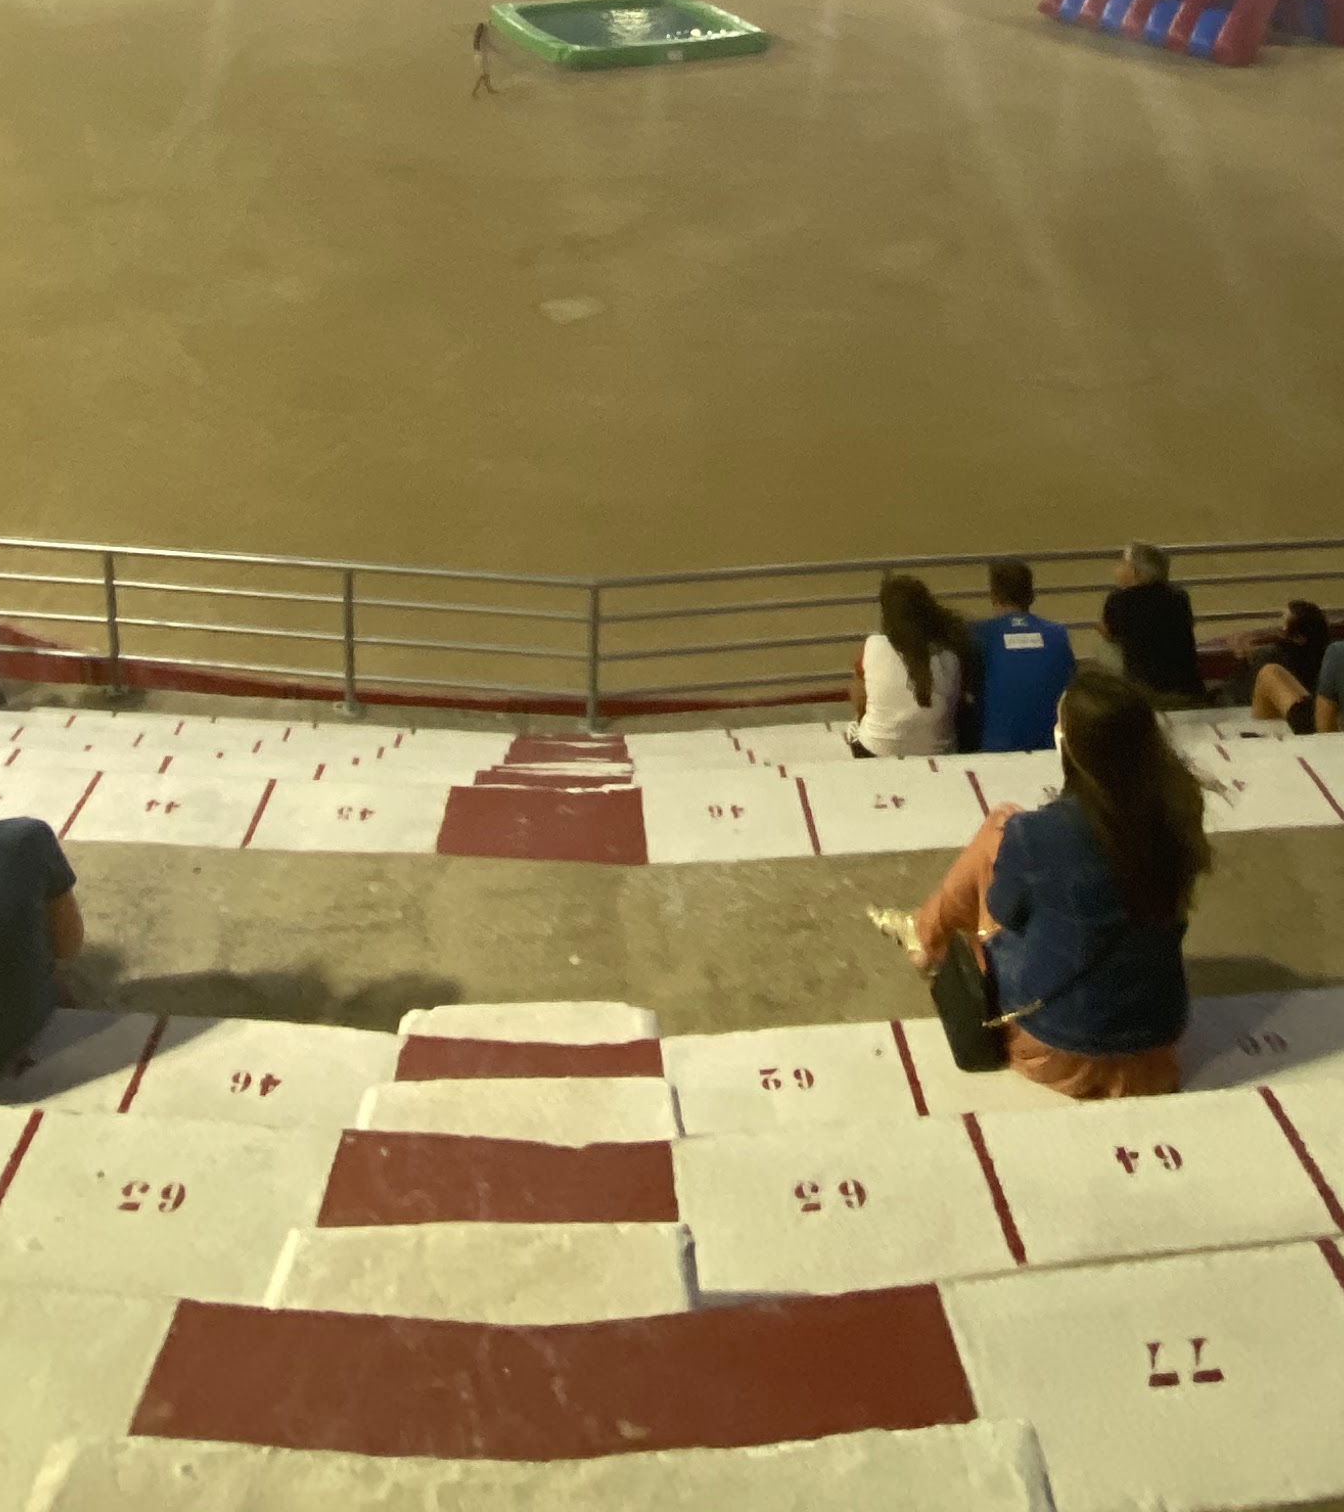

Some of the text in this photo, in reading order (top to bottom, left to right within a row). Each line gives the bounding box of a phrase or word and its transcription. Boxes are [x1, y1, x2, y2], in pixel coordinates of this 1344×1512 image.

[145, 799, 181, 815] 44
[873, 794, 906, 810] 47
[230, 1071, 282, 1097] 46
[759, 1067, 815, 1091] 62
[1114, 1144, 1183, 1175] 64
[1146, 1337, 1225, 1388] 77
